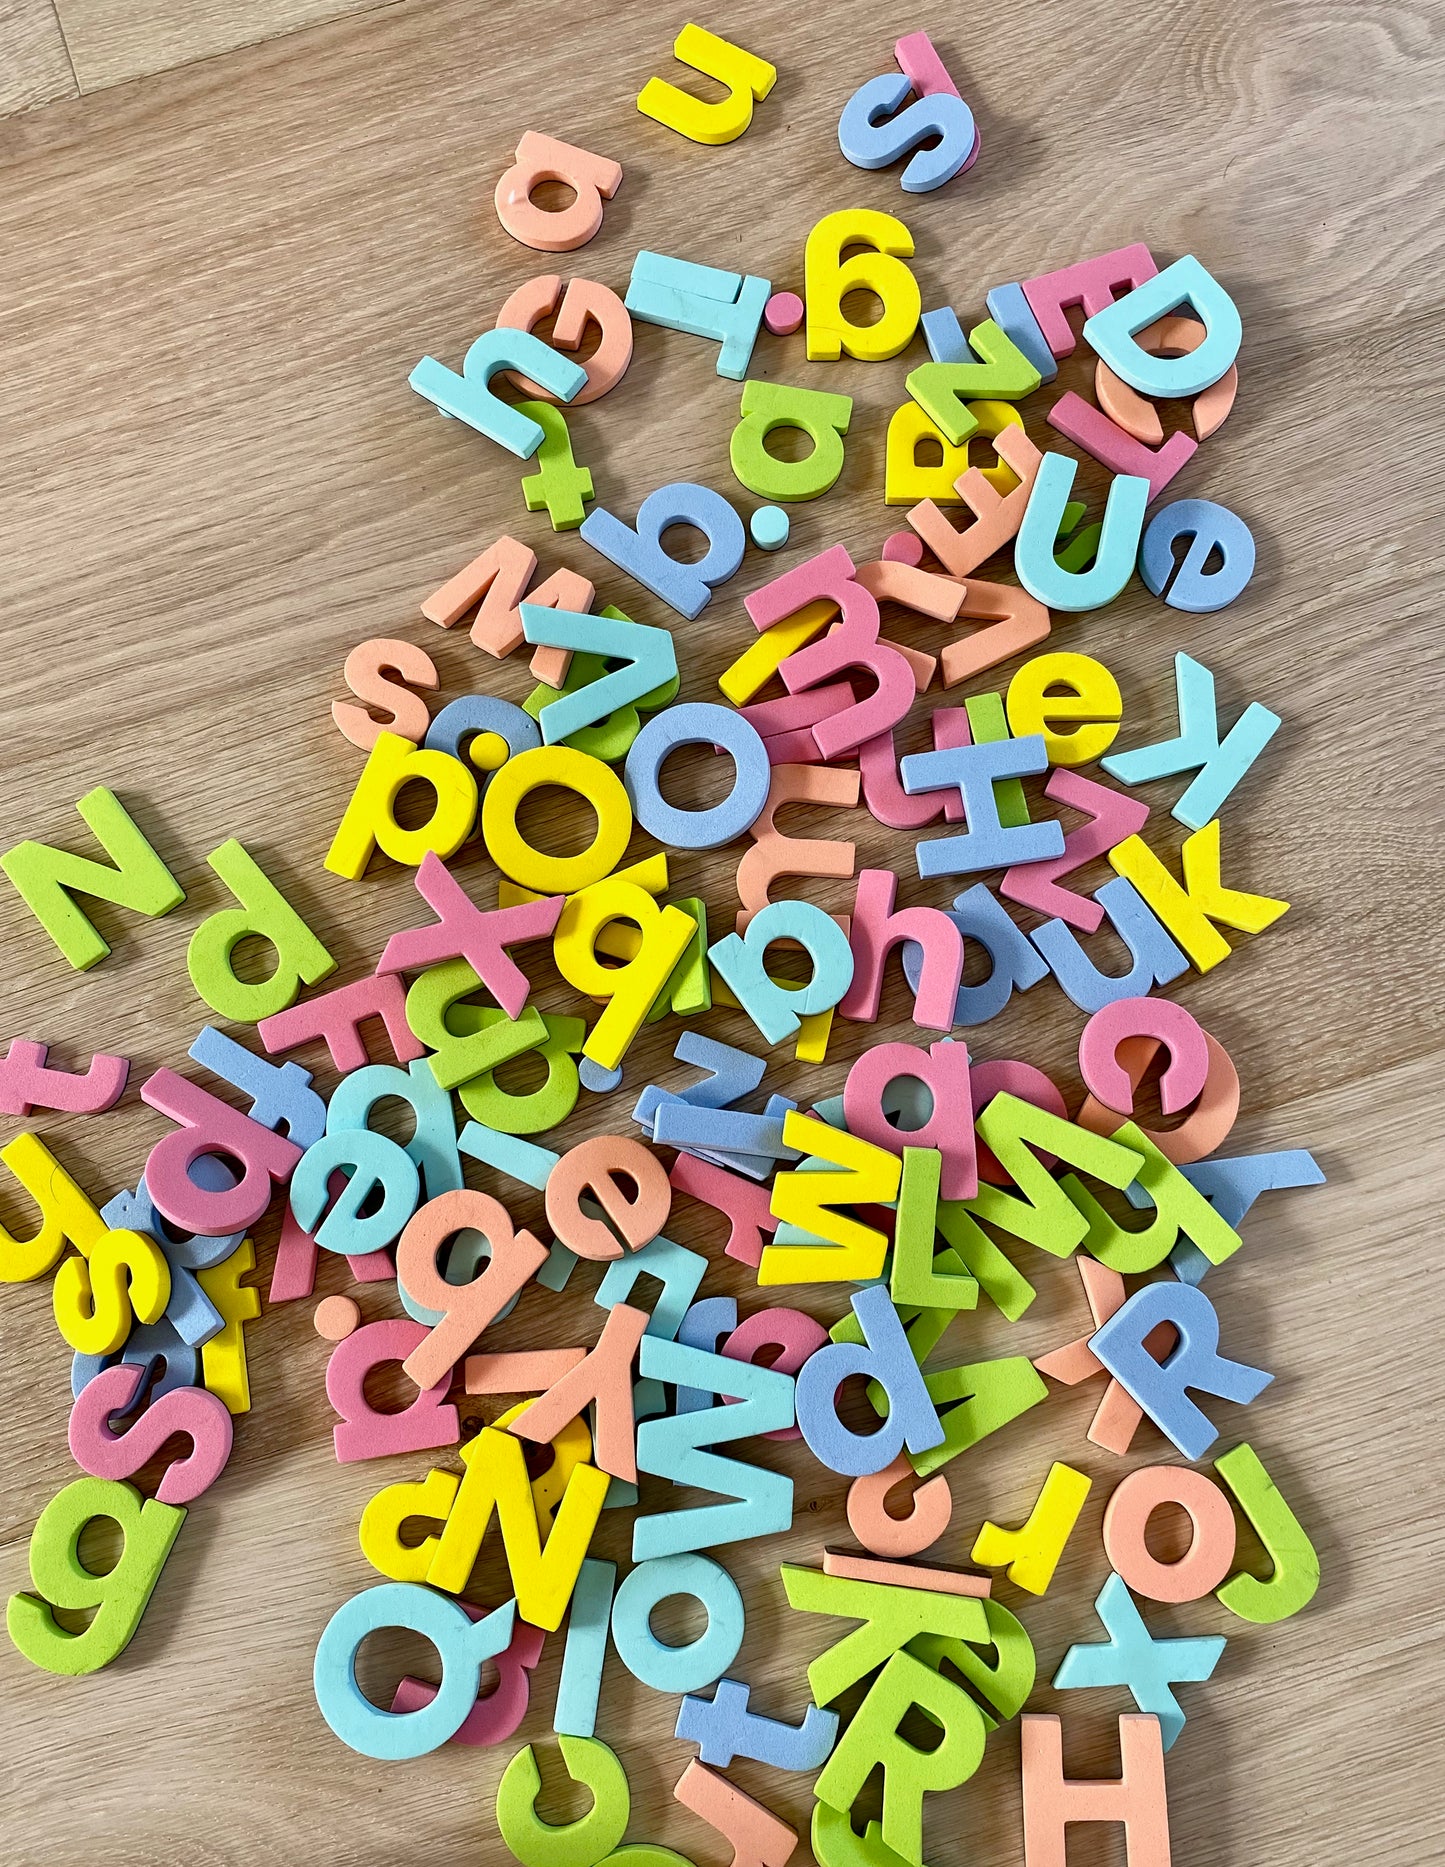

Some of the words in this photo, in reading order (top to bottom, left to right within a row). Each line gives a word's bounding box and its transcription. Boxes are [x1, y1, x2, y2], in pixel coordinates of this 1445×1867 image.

[1083, 254, 1243, 397] D
[1014, 452, 1150, 612] U
[1139, 499, 1256, 612] e
[1006, 652, 1123, 768] e
[901, 733, 1066, 880] H
[187, 838, 339, 1024] d
[838, 868, 964, 1032] h
[140, 1067, 304, 1236] d
[290, 1128, 420, 1255] e
[545, 1135, 671, 1261] e
[891, 1145, 979, 1310] L
[795, 1284, 946, 1477] d
[1087, 1281, 1275, 1461] R
[6, 1476, 189, 1676] g
[1213, 1442, 1320, 1624] J
[813, 1649, 987, 1867] R
[1020, 1713, 1171, 1867] H
